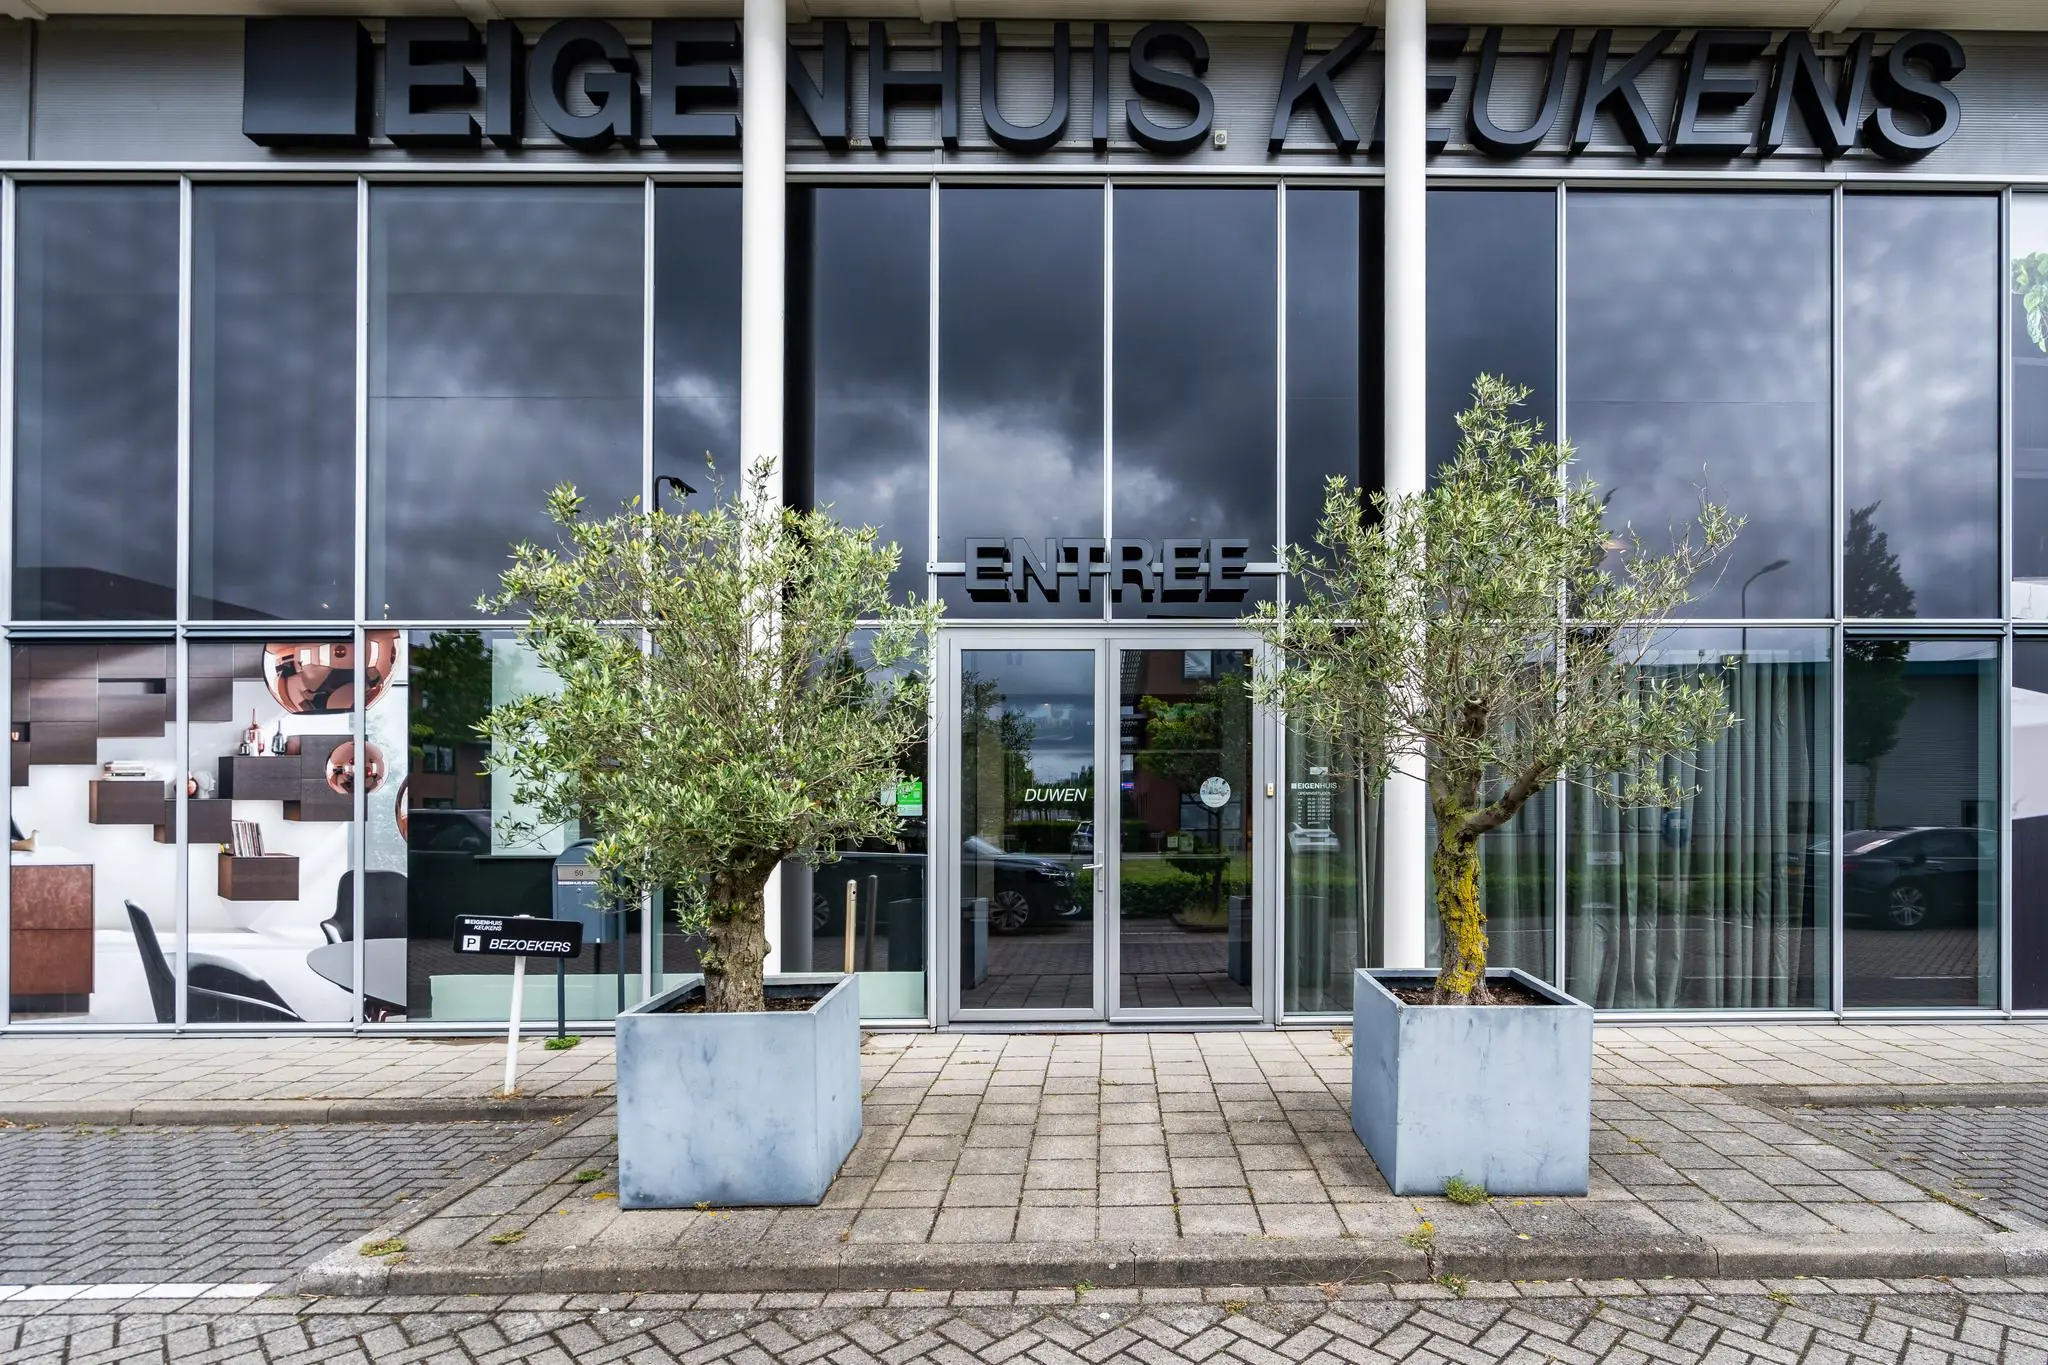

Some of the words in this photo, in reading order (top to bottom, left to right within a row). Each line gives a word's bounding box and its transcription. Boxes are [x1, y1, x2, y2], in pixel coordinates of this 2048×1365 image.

[384, 17, 1214, 152] EIGENHUIS
[1267, 23, 1967, 160] KEUKENS
[965, 537, 1250, 603] ENTREE
[1024, 788, 1087, 802] DUWEN
[466, 937, 477, 949] P
[488, 938, 572, 953] BEZOEKERS
